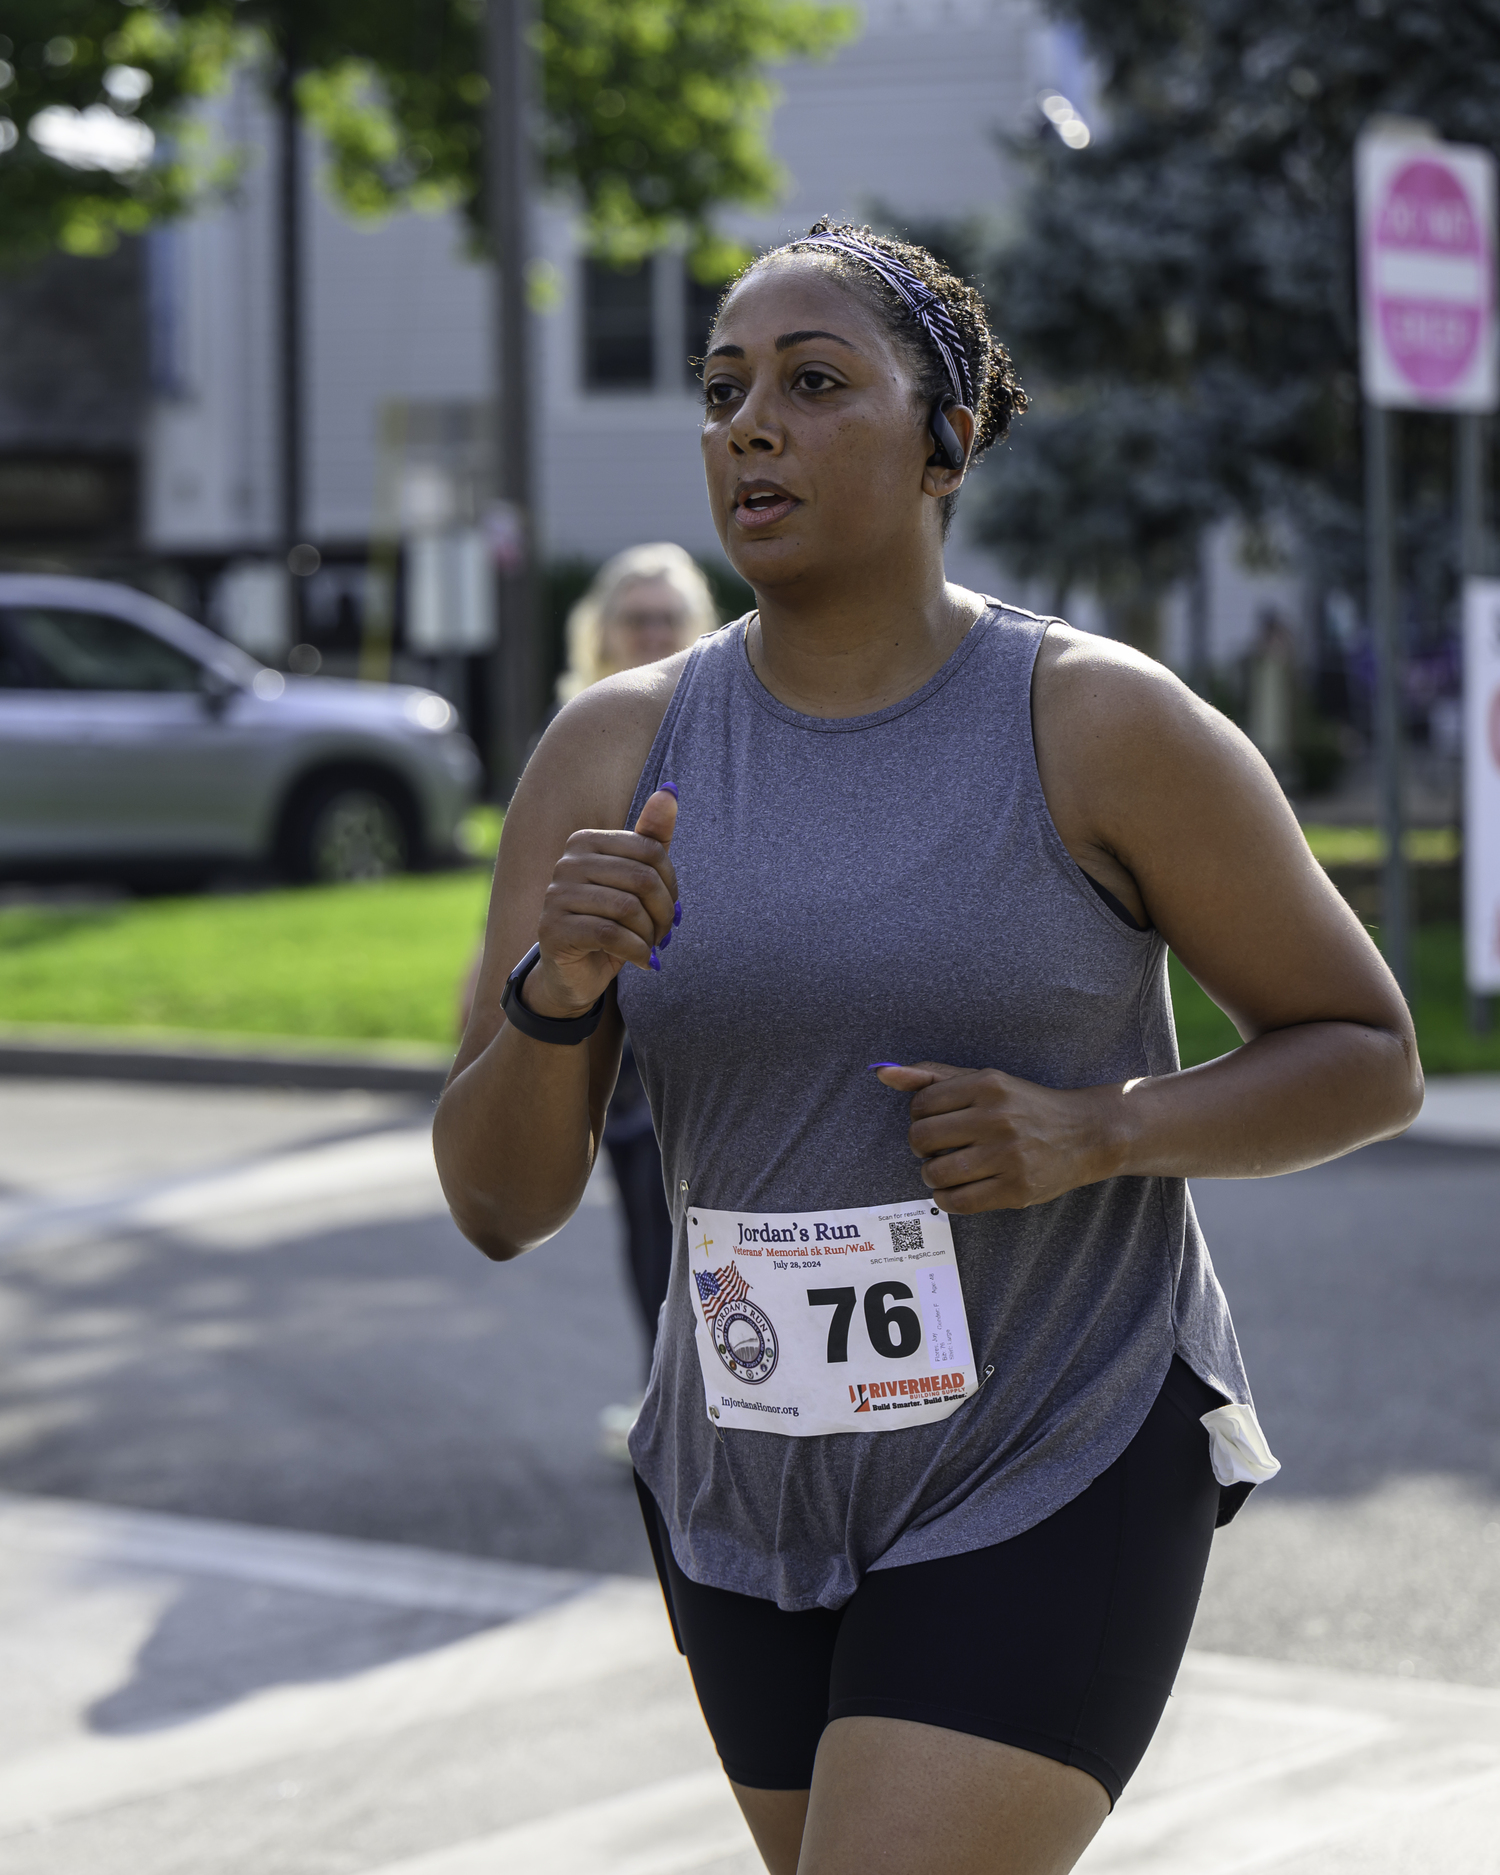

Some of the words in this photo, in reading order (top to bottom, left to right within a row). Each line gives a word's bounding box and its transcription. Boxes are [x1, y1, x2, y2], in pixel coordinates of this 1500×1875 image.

[878, 1214, 892, 1222] Scan
[893, 1212, 902, 1220] for
[903, 1210, 926, 1219] results:
[813, 1223, 861, 1241] Run
[765, 1246, 809, 1257] Memorial
[811, 1246, 823, 1256] 5k
[823, 1241, 876, 1256] Run/Walk
[870, 1257, 882, 1265] SRC
[883, 1255, 904, 1265] Timing
[908, 1249, 946, 1262] RegSRC.com
[773, 1260, 789, 1270] July
[790, 1261, 801, 1269] 28,
[802, 1260, 822, 1268] 2024
[749, 1310, 768, 1333] RUN
[806, 1280, 922, 1364] 76
[868, 1372, 965, 1399] RIVERHEAD
[909, 1391, 940, 1400] BUILDING
[941, 1387, 966, 1395] SUPPLY
[721, 1396, 800, 1417] InJordansHonor.org
[872, 1402, 891, 1412] Build
[892, 1399, 922, 1410] Smarter.
[924, 1396, 942, 1406] Build
[944, 1393, 967, 1402] Better.
